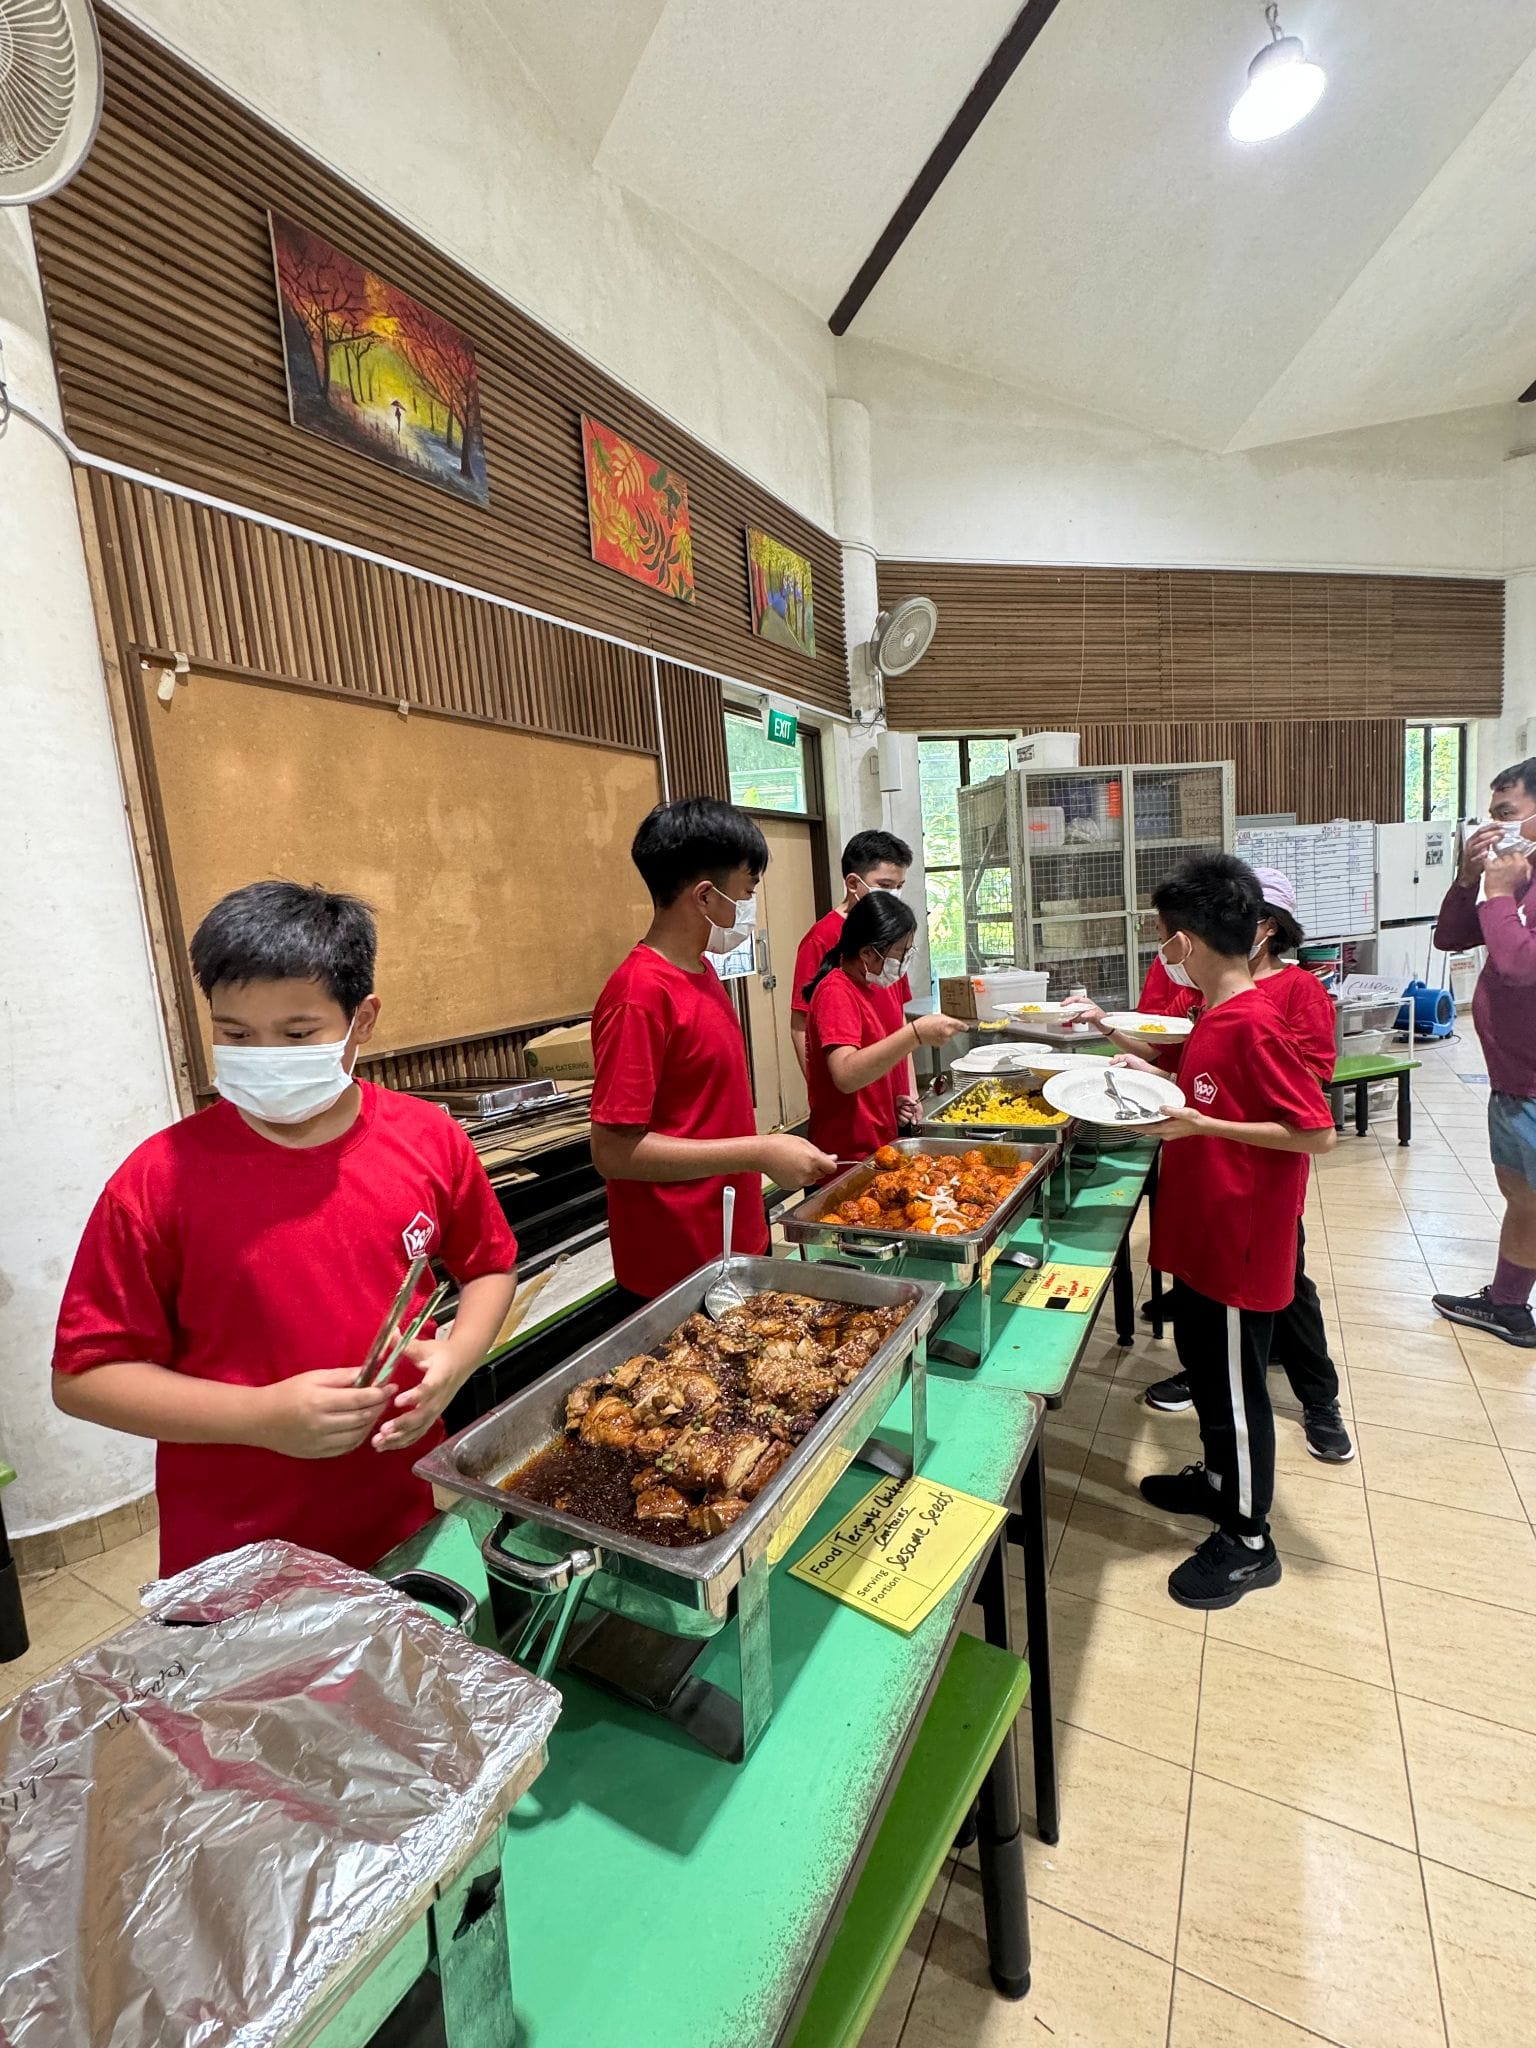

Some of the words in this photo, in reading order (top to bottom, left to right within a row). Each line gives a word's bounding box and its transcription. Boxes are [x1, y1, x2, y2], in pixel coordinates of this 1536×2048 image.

[774, 717, 791, 740] EXIT
[811, 1547, 843, 1575] Food
[835, 1508, 881, 1546] Teriyaki
[874, 1507, 909, 1546] Contains
[887, 1527, 931, 1571] Sesame
[920, 1491, 954, 1526] Seeds
[857, 1569, 889, 1597] Serving
[872, 1576, 901, 1604] Portion
